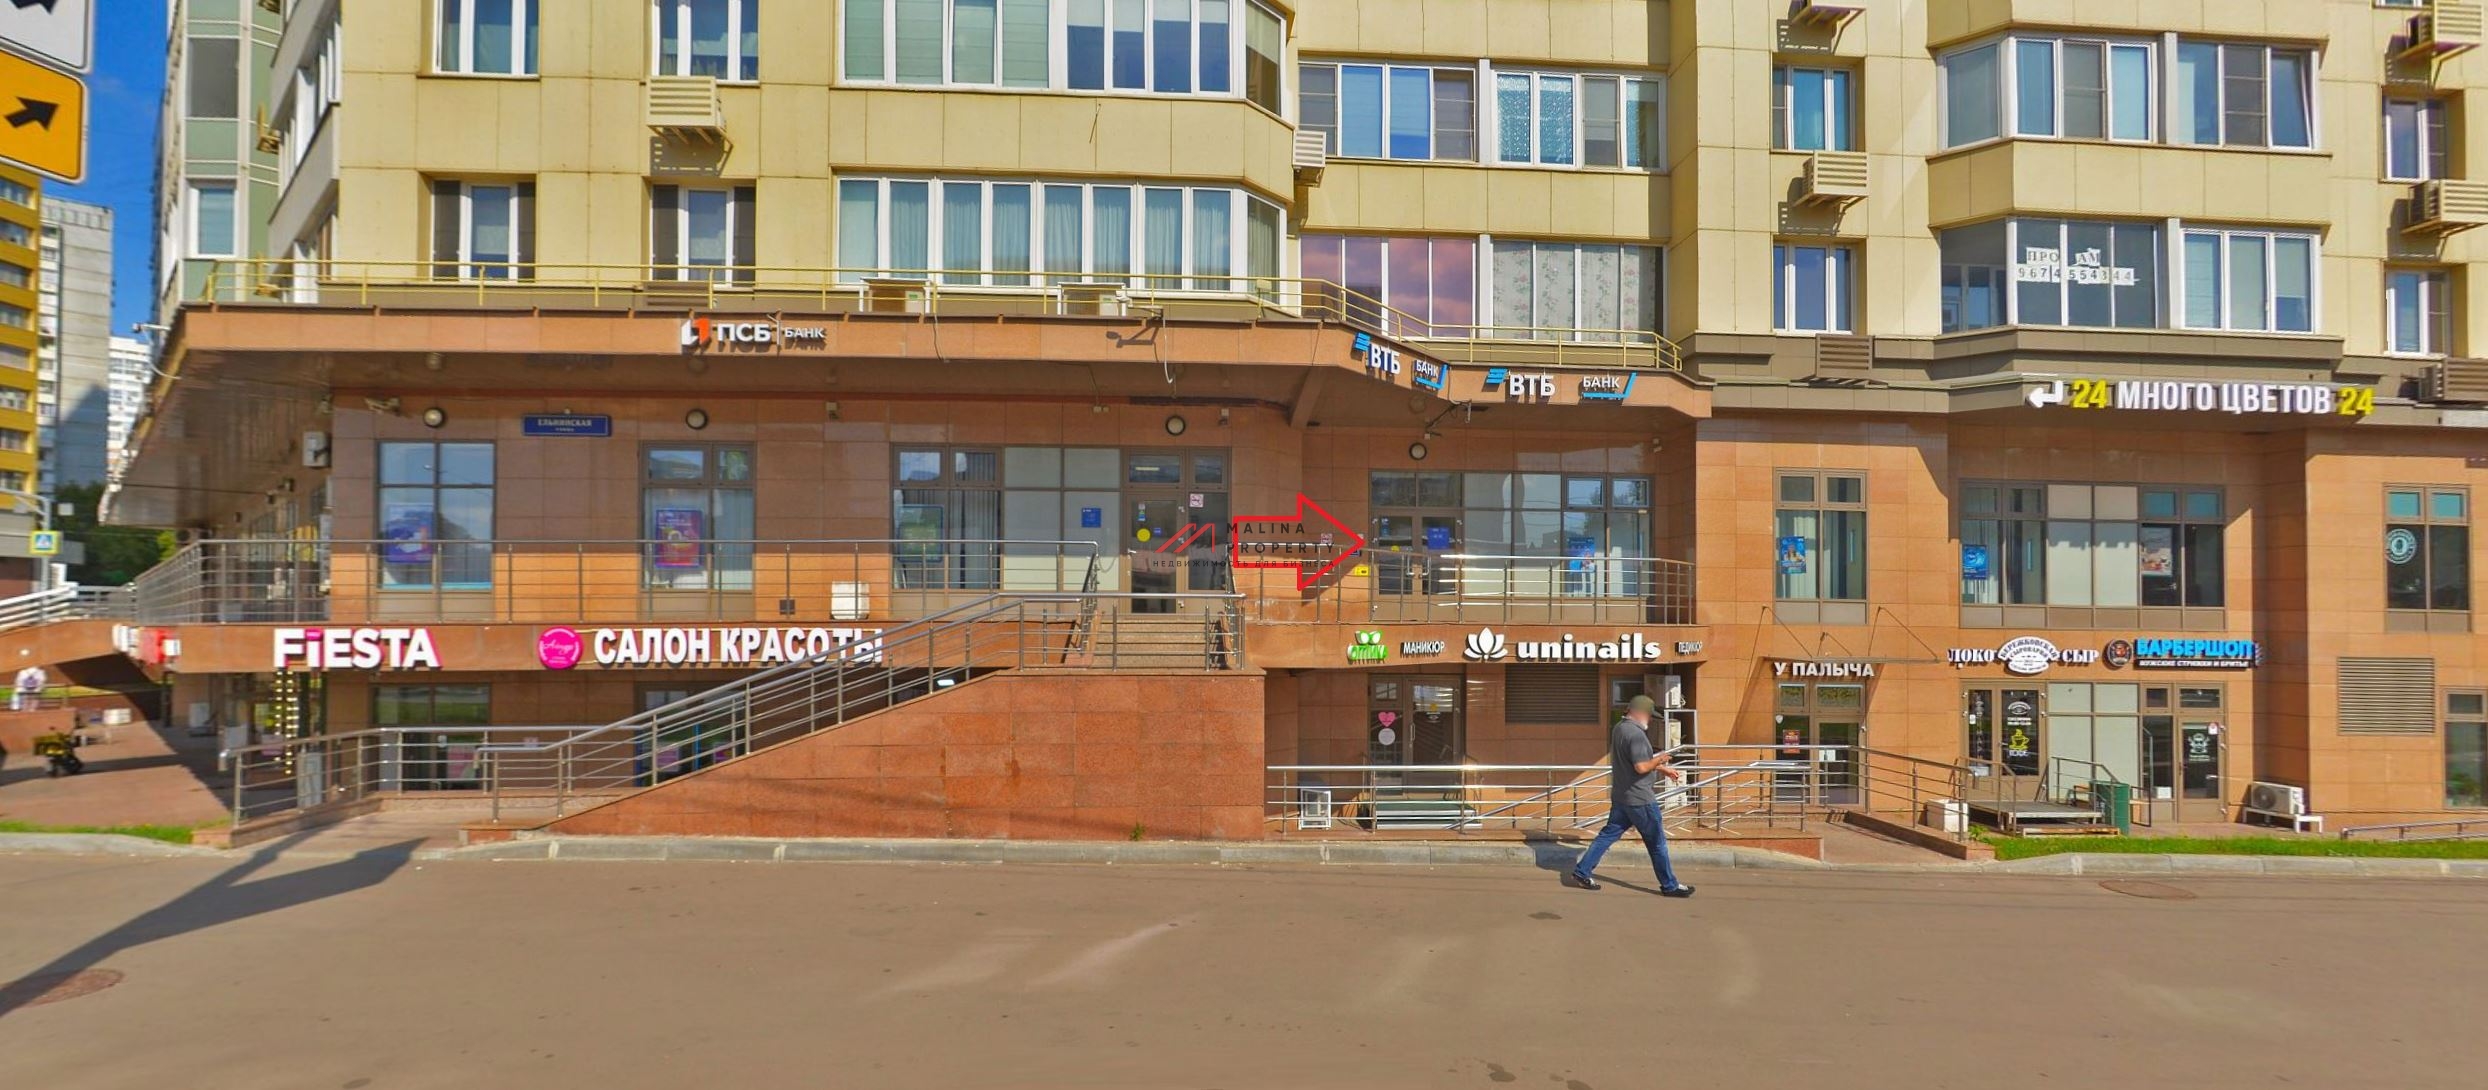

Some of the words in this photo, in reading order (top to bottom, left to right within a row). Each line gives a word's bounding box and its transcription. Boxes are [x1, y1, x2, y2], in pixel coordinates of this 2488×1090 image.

[717, 323, 771, 342] ПСБ
[784, 327, 826, 338] БАНК
[1370, 344, 1401, 374] ВТБ
[1415, 359, 1440, 377] БАНК
[1509, 374, 1556, 396] ВТБ
[1583, 376, 1621, 388] БАНК
[2072, 380, 2108, 408] 24
[2117, 381, 2214, 411] МНОГО
[2221, 383, 2332, 414] ЦВЕТОВ
[2338, 387, 2376, 415] 24
[594, 628, 710, 664] САЛОН
[720, 627, 883, 664] КРАСОТЫ
[1403, 641, 1445, 654] МАНИКЮР
[1518, 633, 1661, 660] uninails
[2062, 649, 2099, 663] СЫР
[1774, 662, 1787, 676] У
[1792, 662, 1875, 677] ПАЛЫЧА
